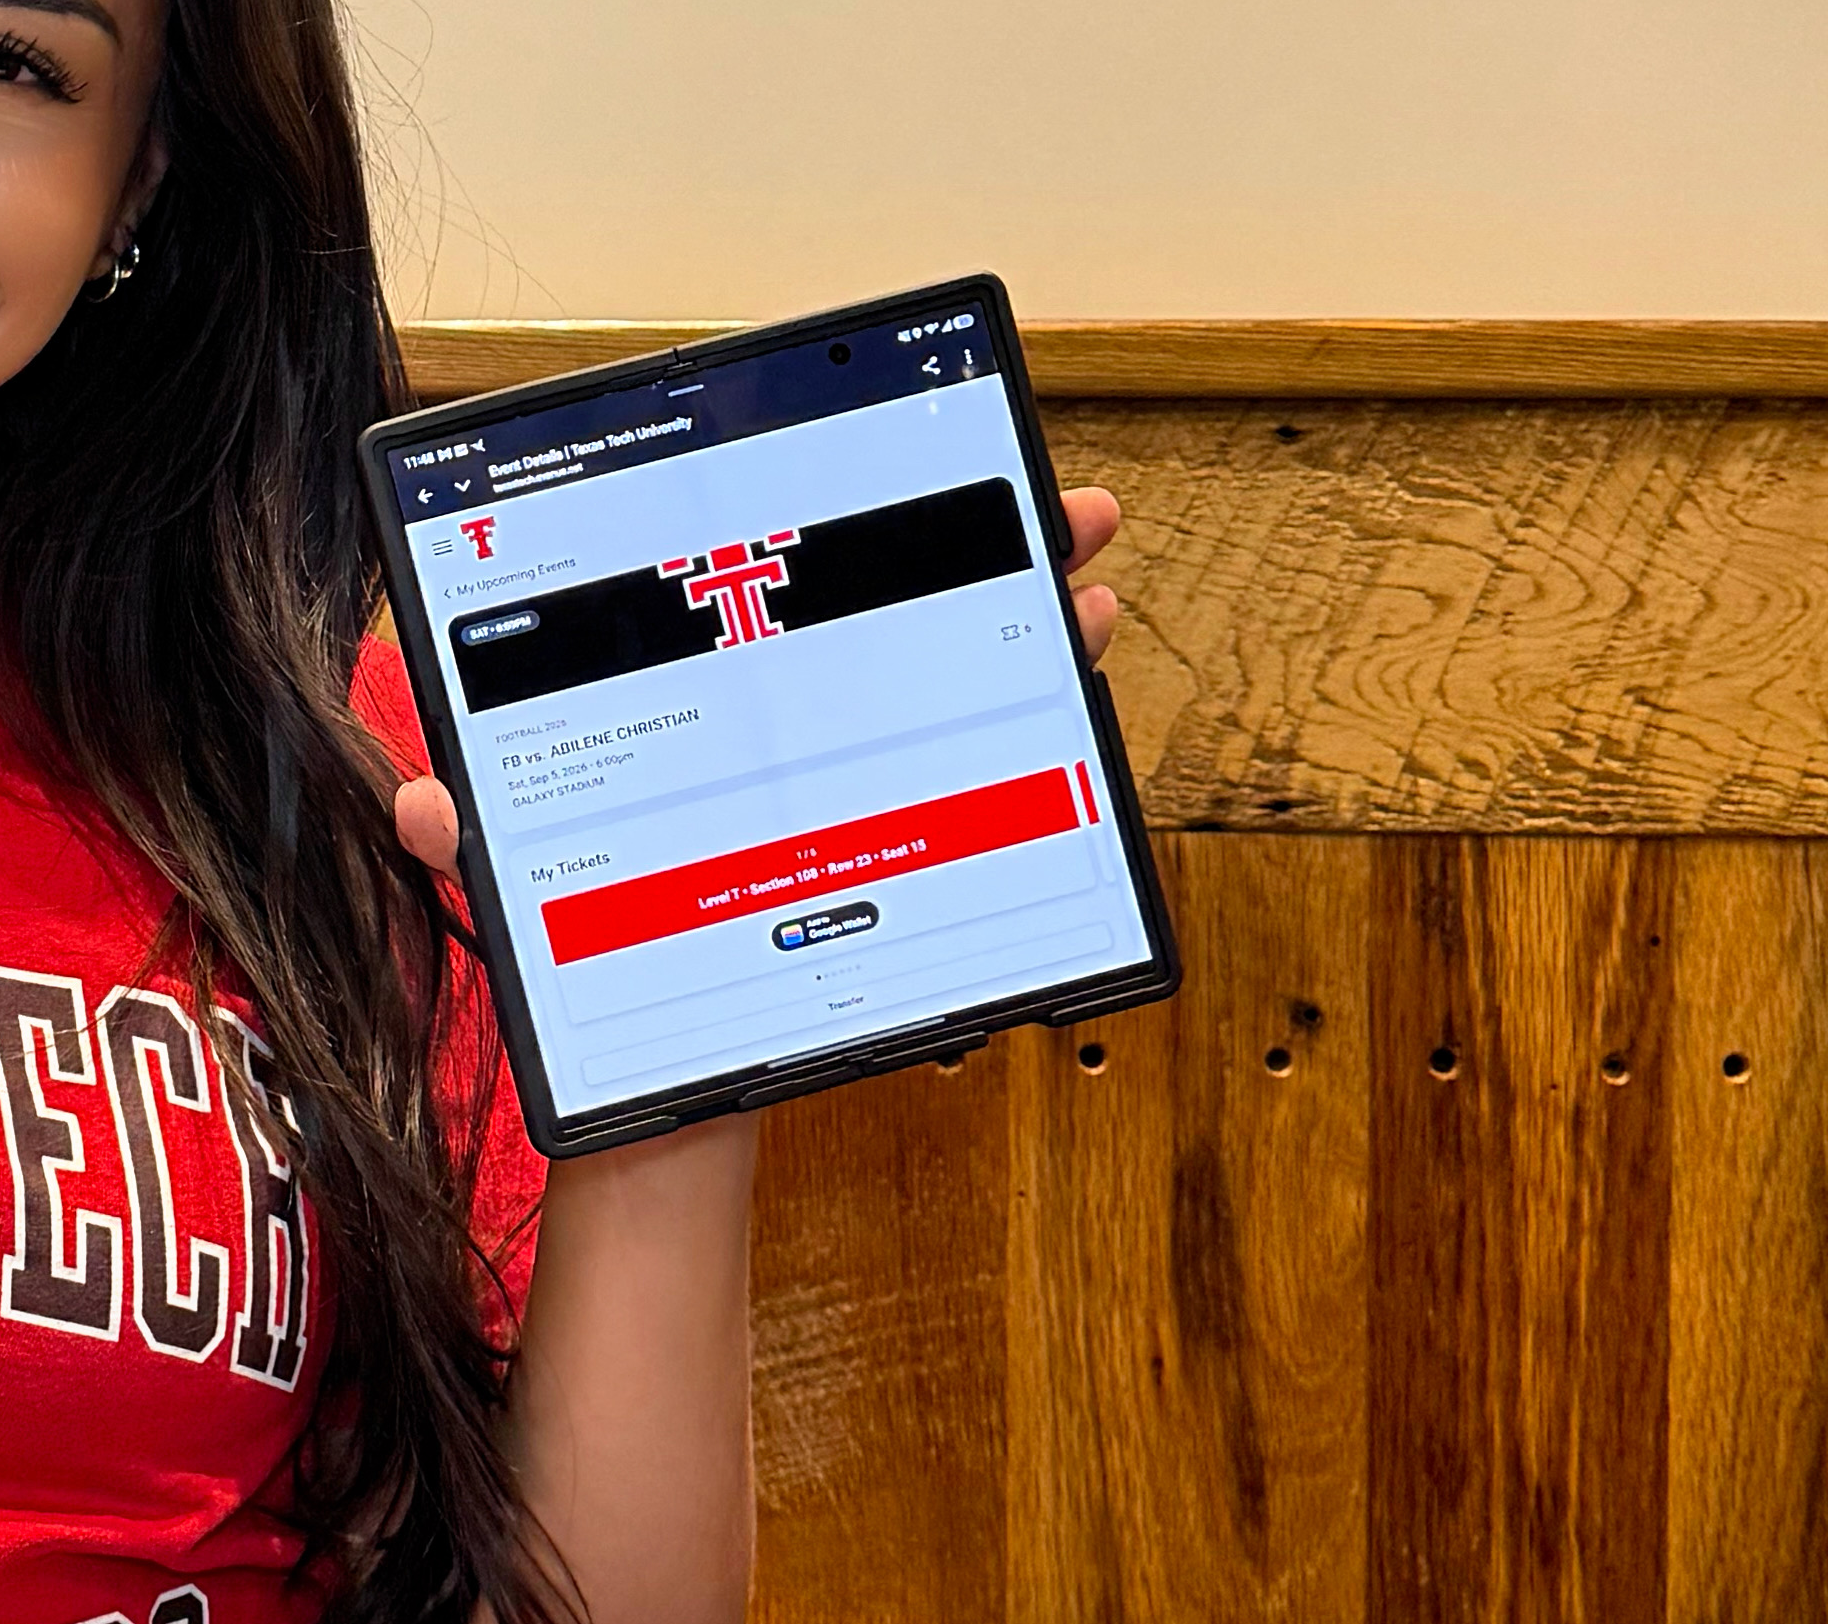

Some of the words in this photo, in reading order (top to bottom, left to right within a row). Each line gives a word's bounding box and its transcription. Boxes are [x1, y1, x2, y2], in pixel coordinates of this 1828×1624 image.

[488, 459, 522, 478] Event
[572, 440, 605, 457] Texas
[606, 431, 634, 450] Tech
[636, 417, 692, 441] University
[456, 585, 474, 597] My
[476, 567, 535, 591] Upcoming
[537, 558, 576, 576] Events
[495, 725, 544, 744] FOOTBALL
[502, 755, 522, 770] FB
[524, 752, 546, 764] vs.
[550, 731, 614, 759] ABILENE
[616, 708, 700, 740] CHRISTIAN
[512, 788, 555, 808] GALAXY
[556, 776, 606, 797] STADIUM
[530, 867, 554, 884] My
[555, 852, 611, 876] Tickets
[698, 888, 731, 909] Level
[750, 874, 794, 897] Section
[828, 859, 853, 877] Row
[881, 843, 909, 862] Seat
